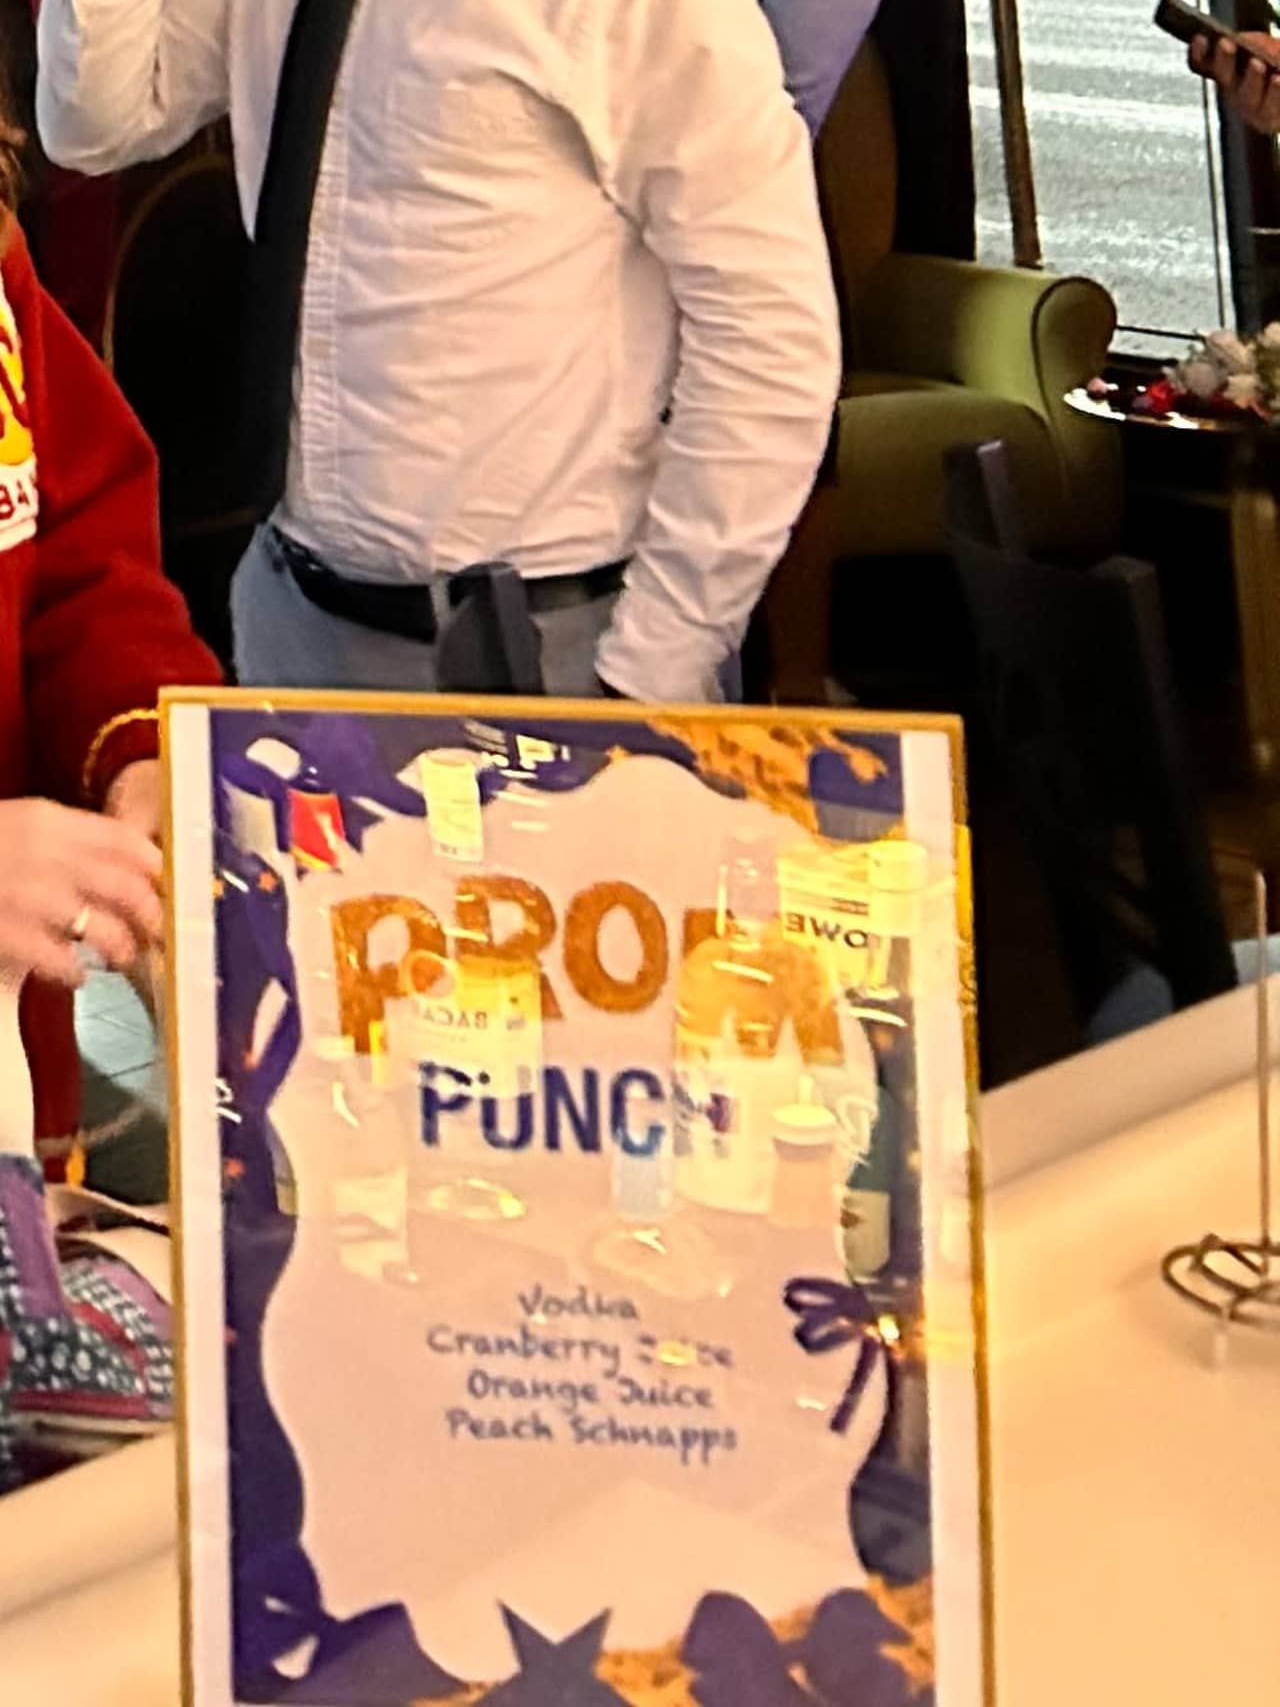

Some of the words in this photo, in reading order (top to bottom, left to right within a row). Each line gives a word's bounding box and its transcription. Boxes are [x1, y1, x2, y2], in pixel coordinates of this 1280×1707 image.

[519, 1283, 638, 1319] Vodka
[426, 1324, 620, 1379] Cranberry
[467, 1367, 598, 1414] Orange
[617, 1376, 713, 1408] Juice
[445, 1407, 553, 1440] Peach
[569, 1413, 738, 1466] Schnapps
